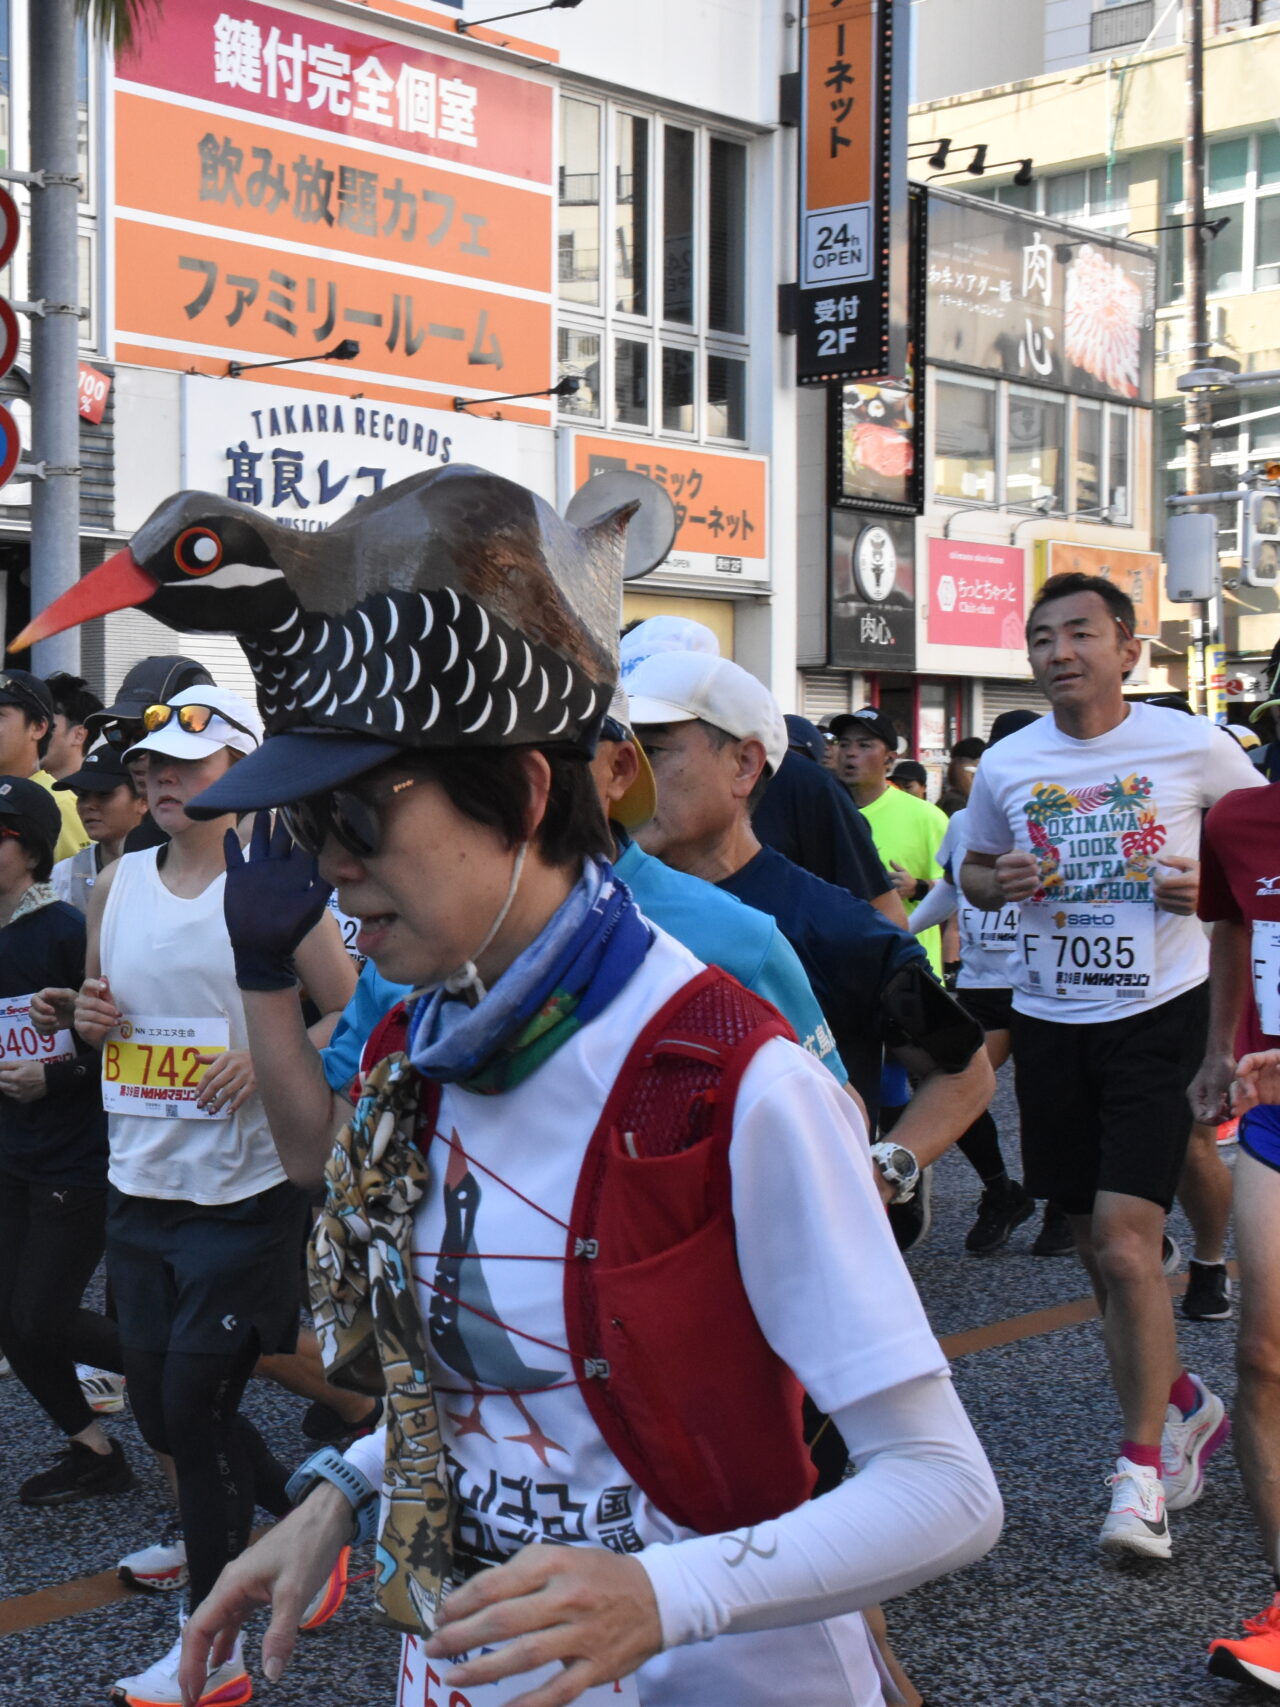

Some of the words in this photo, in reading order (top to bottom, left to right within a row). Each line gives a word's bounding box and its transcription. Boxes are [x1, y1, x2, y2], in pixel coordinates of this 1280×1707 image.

[213, 13, 478, 148] 鍵付完全個室
[824, 0, 855, 158] ーネット
[198, 132, 490, 258] 飲み放題カフェ
[816, 223, 860, 251] 24h
[813, 249, 862, 269] OPEN
[178, 255, 504, 370] ファミリールーム
[814, 295, 860, 324] 受付
[817, 326, 858, 356] 2F
[251, 403, 345, 439] TAKARA
[355, 406, 452, 464] RECORDS
[1048, 812, 1139, 838] OKINAWA
[1068, 836, 1118, 859] 100K
[1063, 860, 1127, 881] ULTRA
[979, 908, 1020, 931] 774
[1067, 913, 1115, 927] sato
[1023, 934, 1041, 966] F
[1051, 936, 1135, 969] 7035
[148, 1028, 196, 1038] エヌエヌ生命
[106, 1043, 120, 1081] B
[137, 1044, 201, 1087] 742
